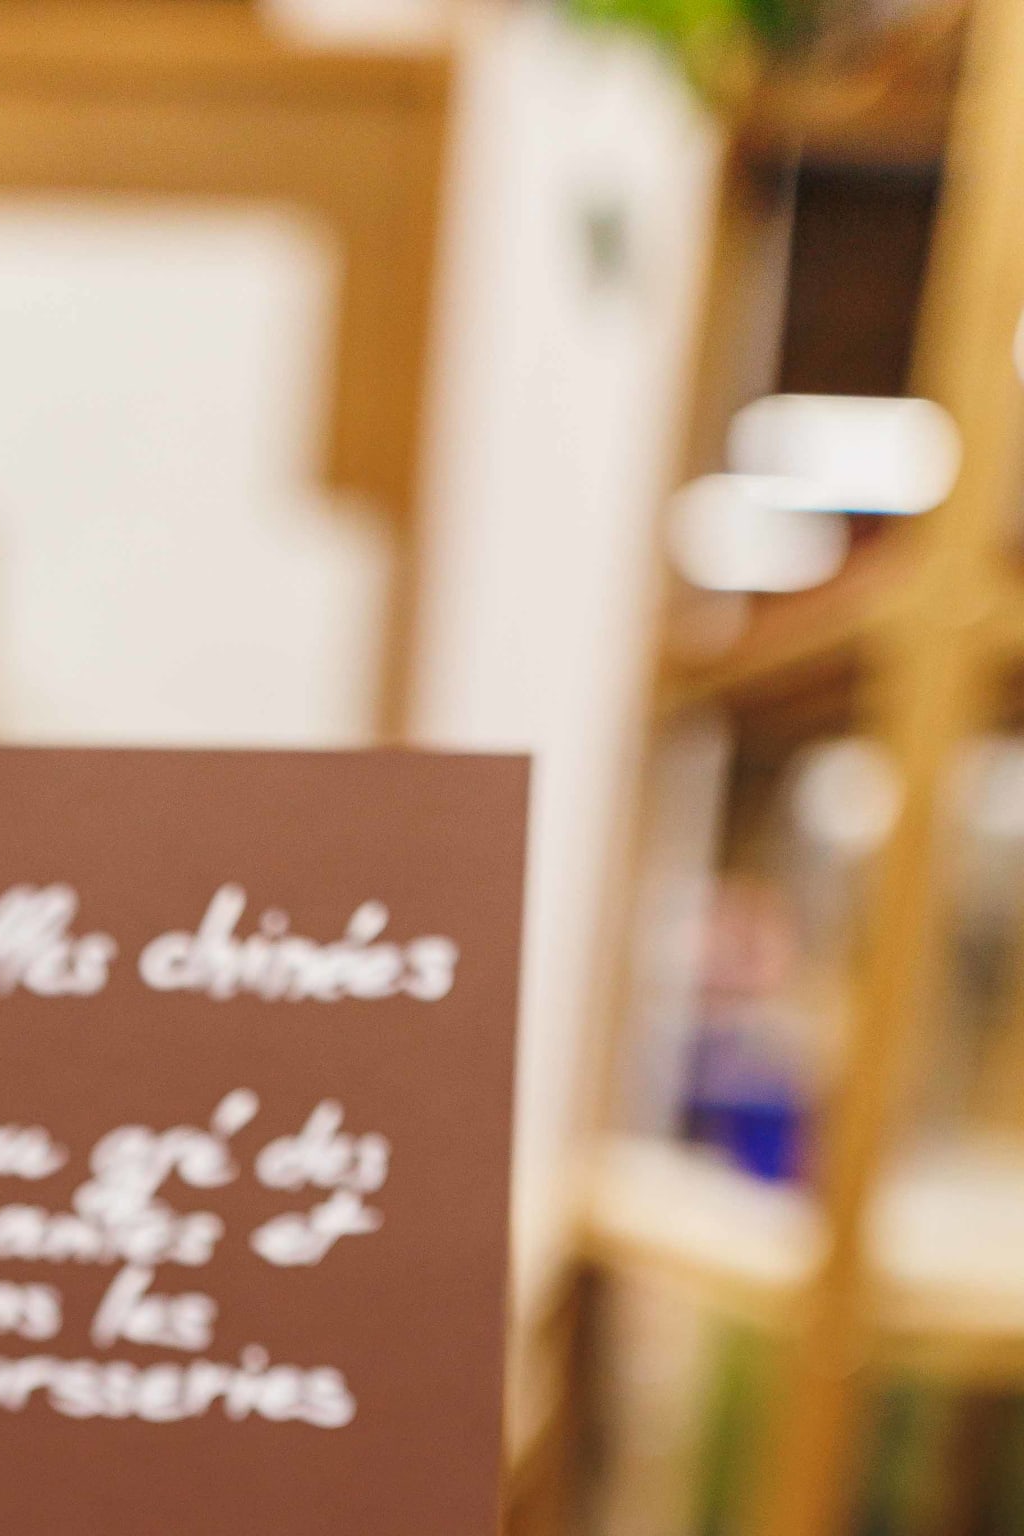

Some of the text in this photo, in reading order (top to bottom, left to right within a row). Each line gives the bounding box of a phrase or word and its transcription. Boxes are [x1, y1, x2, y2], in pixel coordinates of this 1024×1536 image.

[254, 1099, 390, 1194] des
[251, 1188, 382, 1267] et
[92, 1262, 219, 1350] les
